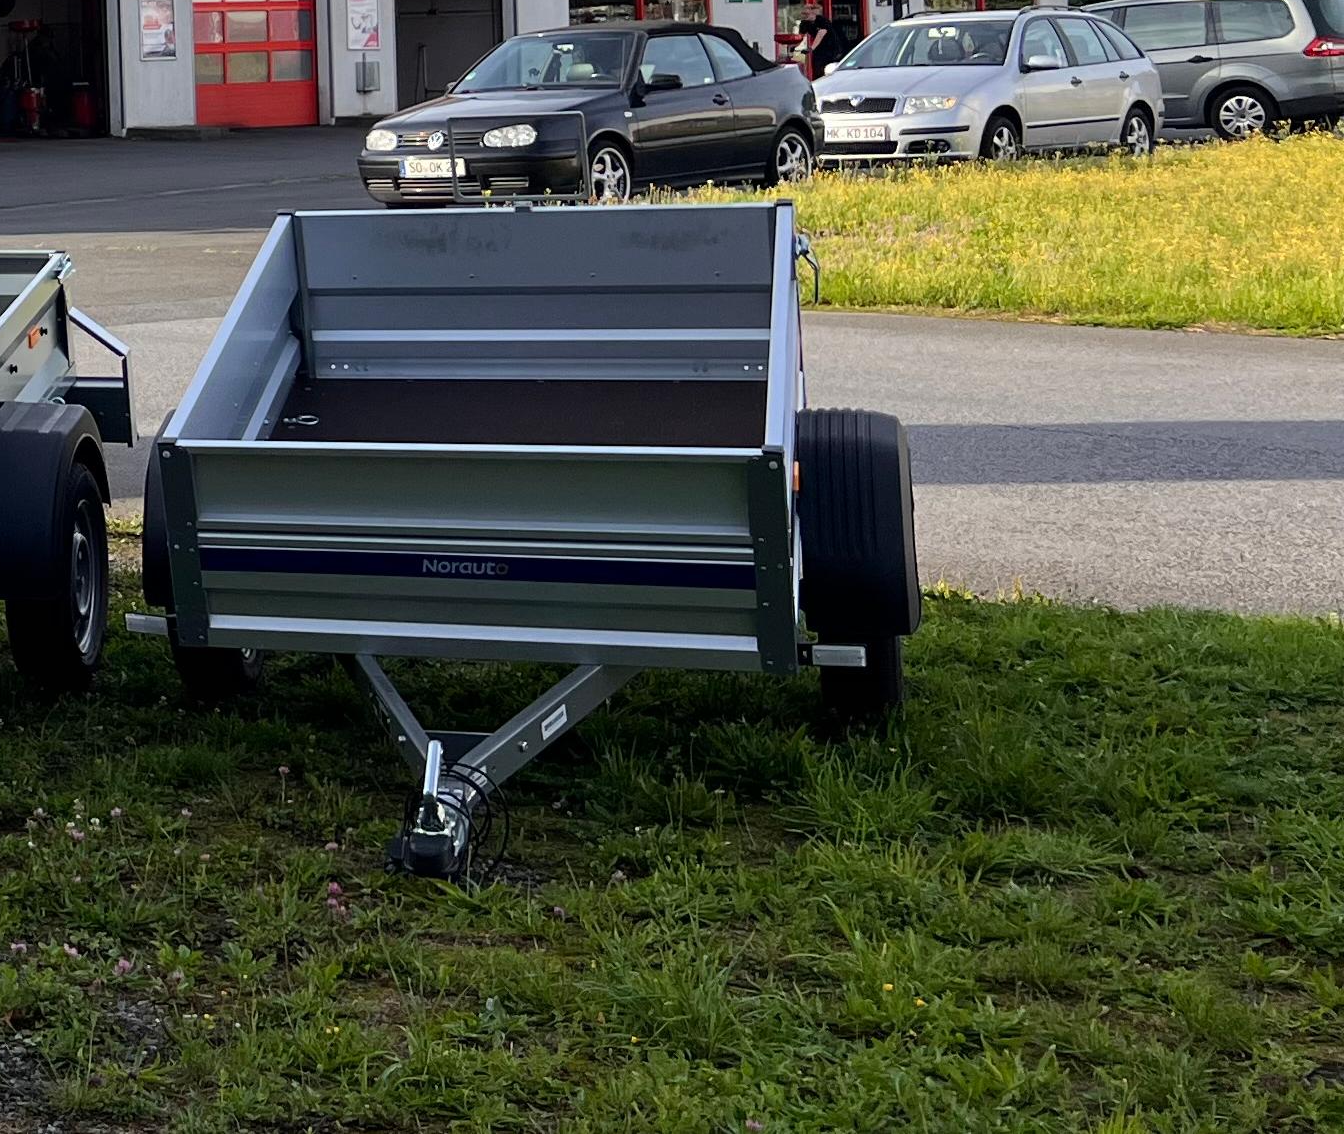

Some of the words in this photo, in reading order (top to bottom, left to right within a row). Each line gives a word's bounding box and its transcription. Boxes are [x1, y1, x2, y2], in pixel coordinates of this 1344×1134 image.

[826, 128, 840, 139] MK
[863, 127, 883, 139] 104
[408, 161, 423, 173] SO
[422, 558, 509, 576] Norauto
